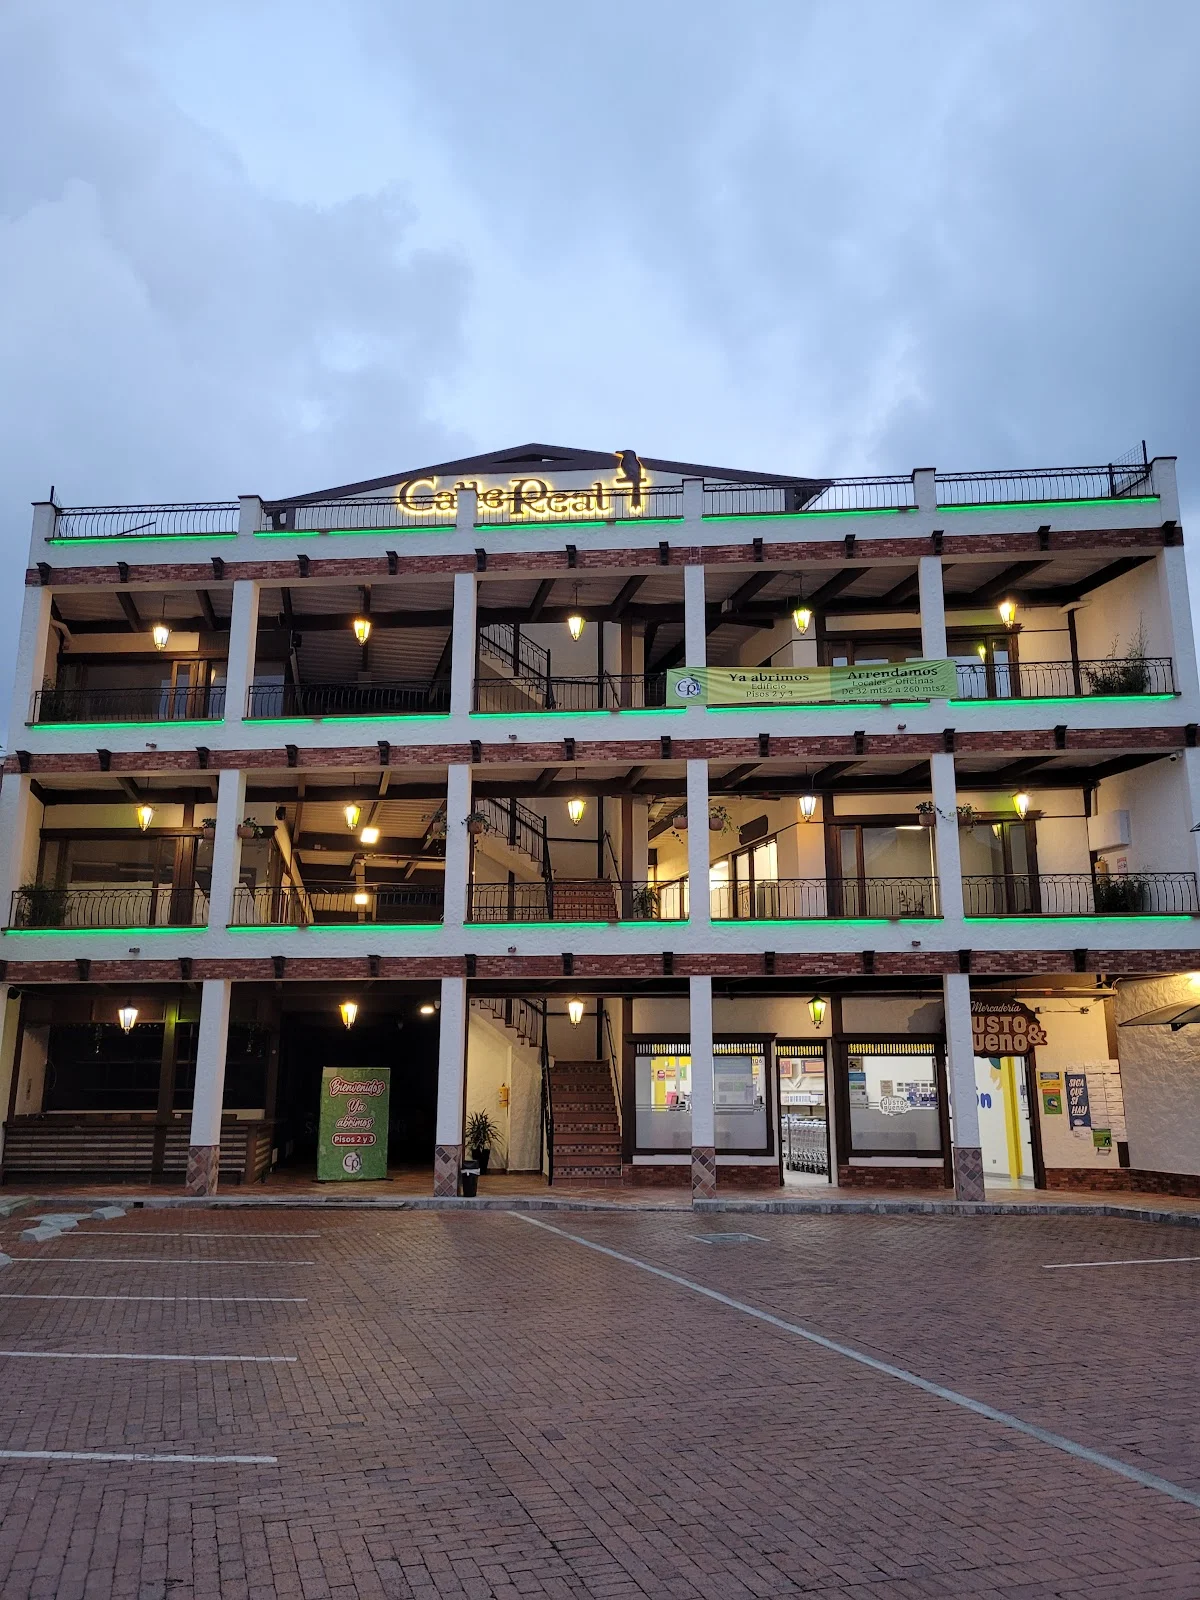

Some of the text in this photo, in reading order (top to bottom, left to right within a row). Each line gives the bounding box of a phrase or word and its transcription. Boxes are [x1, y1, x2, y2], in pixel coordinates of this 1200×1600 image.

[399, 477, 609, 515] Cae Real
[729, 672, 810, 682] Ya abrimos
[847, 667, 938, 679] Arrendamos
[895, 678, 934, 686] Oficinas
[746, 690, 769, 698] Pisos
[857, 687, 867, 695] 32
[870, 686, 892, 694] mts2
[904, 685, 920, 693] 260
[923, 684, 946, 692] mts2
[972, 1016, 1027, 1033] USTO
[1028, 1024, 1046, 1044] &
[331, 1079, 384, 1095] Bienvenidos
[1069, 1078, 1084, 1087] SIGA
[1070, 1087, 1084, 1097] QUE
[348, 1099, 365, 1114] Ya
[336, 1115, 373, 1129] abrimos
[335, 1135, 355, 1143] Pisos
